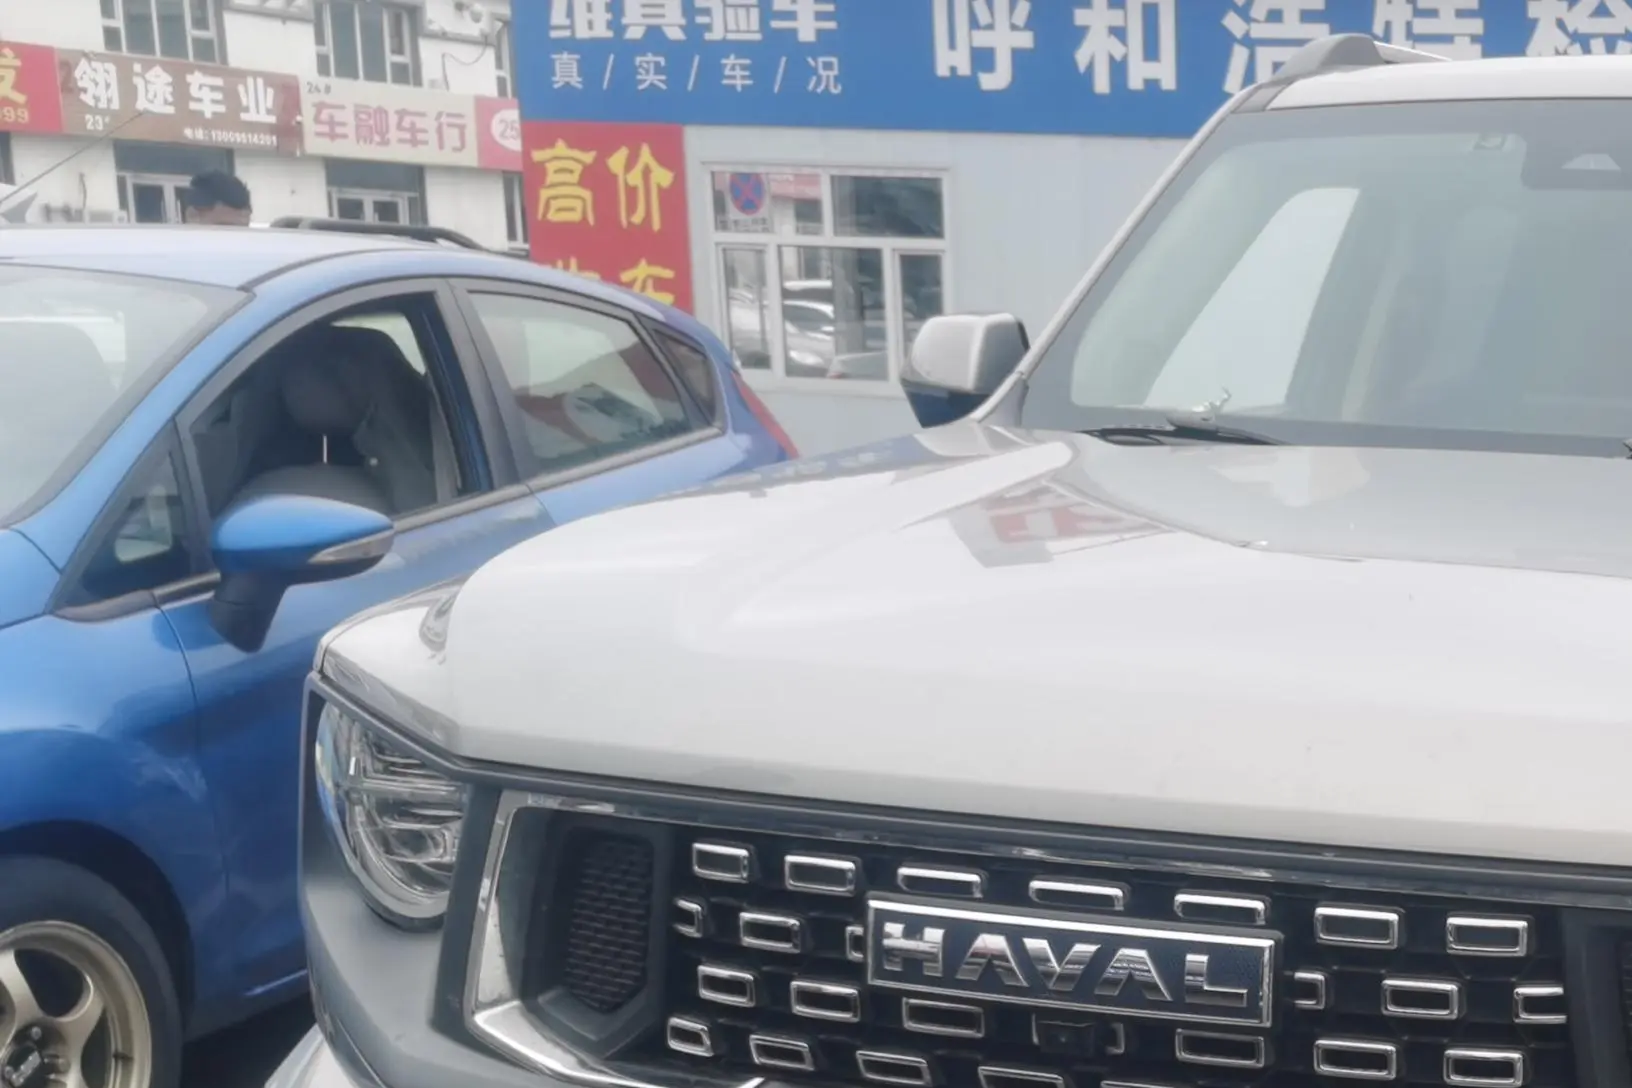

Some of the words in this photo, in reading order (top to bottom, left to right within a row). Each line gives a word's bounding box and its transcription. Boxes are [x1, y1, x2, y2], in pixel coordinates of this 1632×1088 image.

[74, 57, 277, 124] 翎途车业
[312, 101, 467, 152] 车融车行
[531, 138, 675, 232] 高价
[555, 256, 675, 306] 车
[881, 920, 1248, 1008] HAVAL
